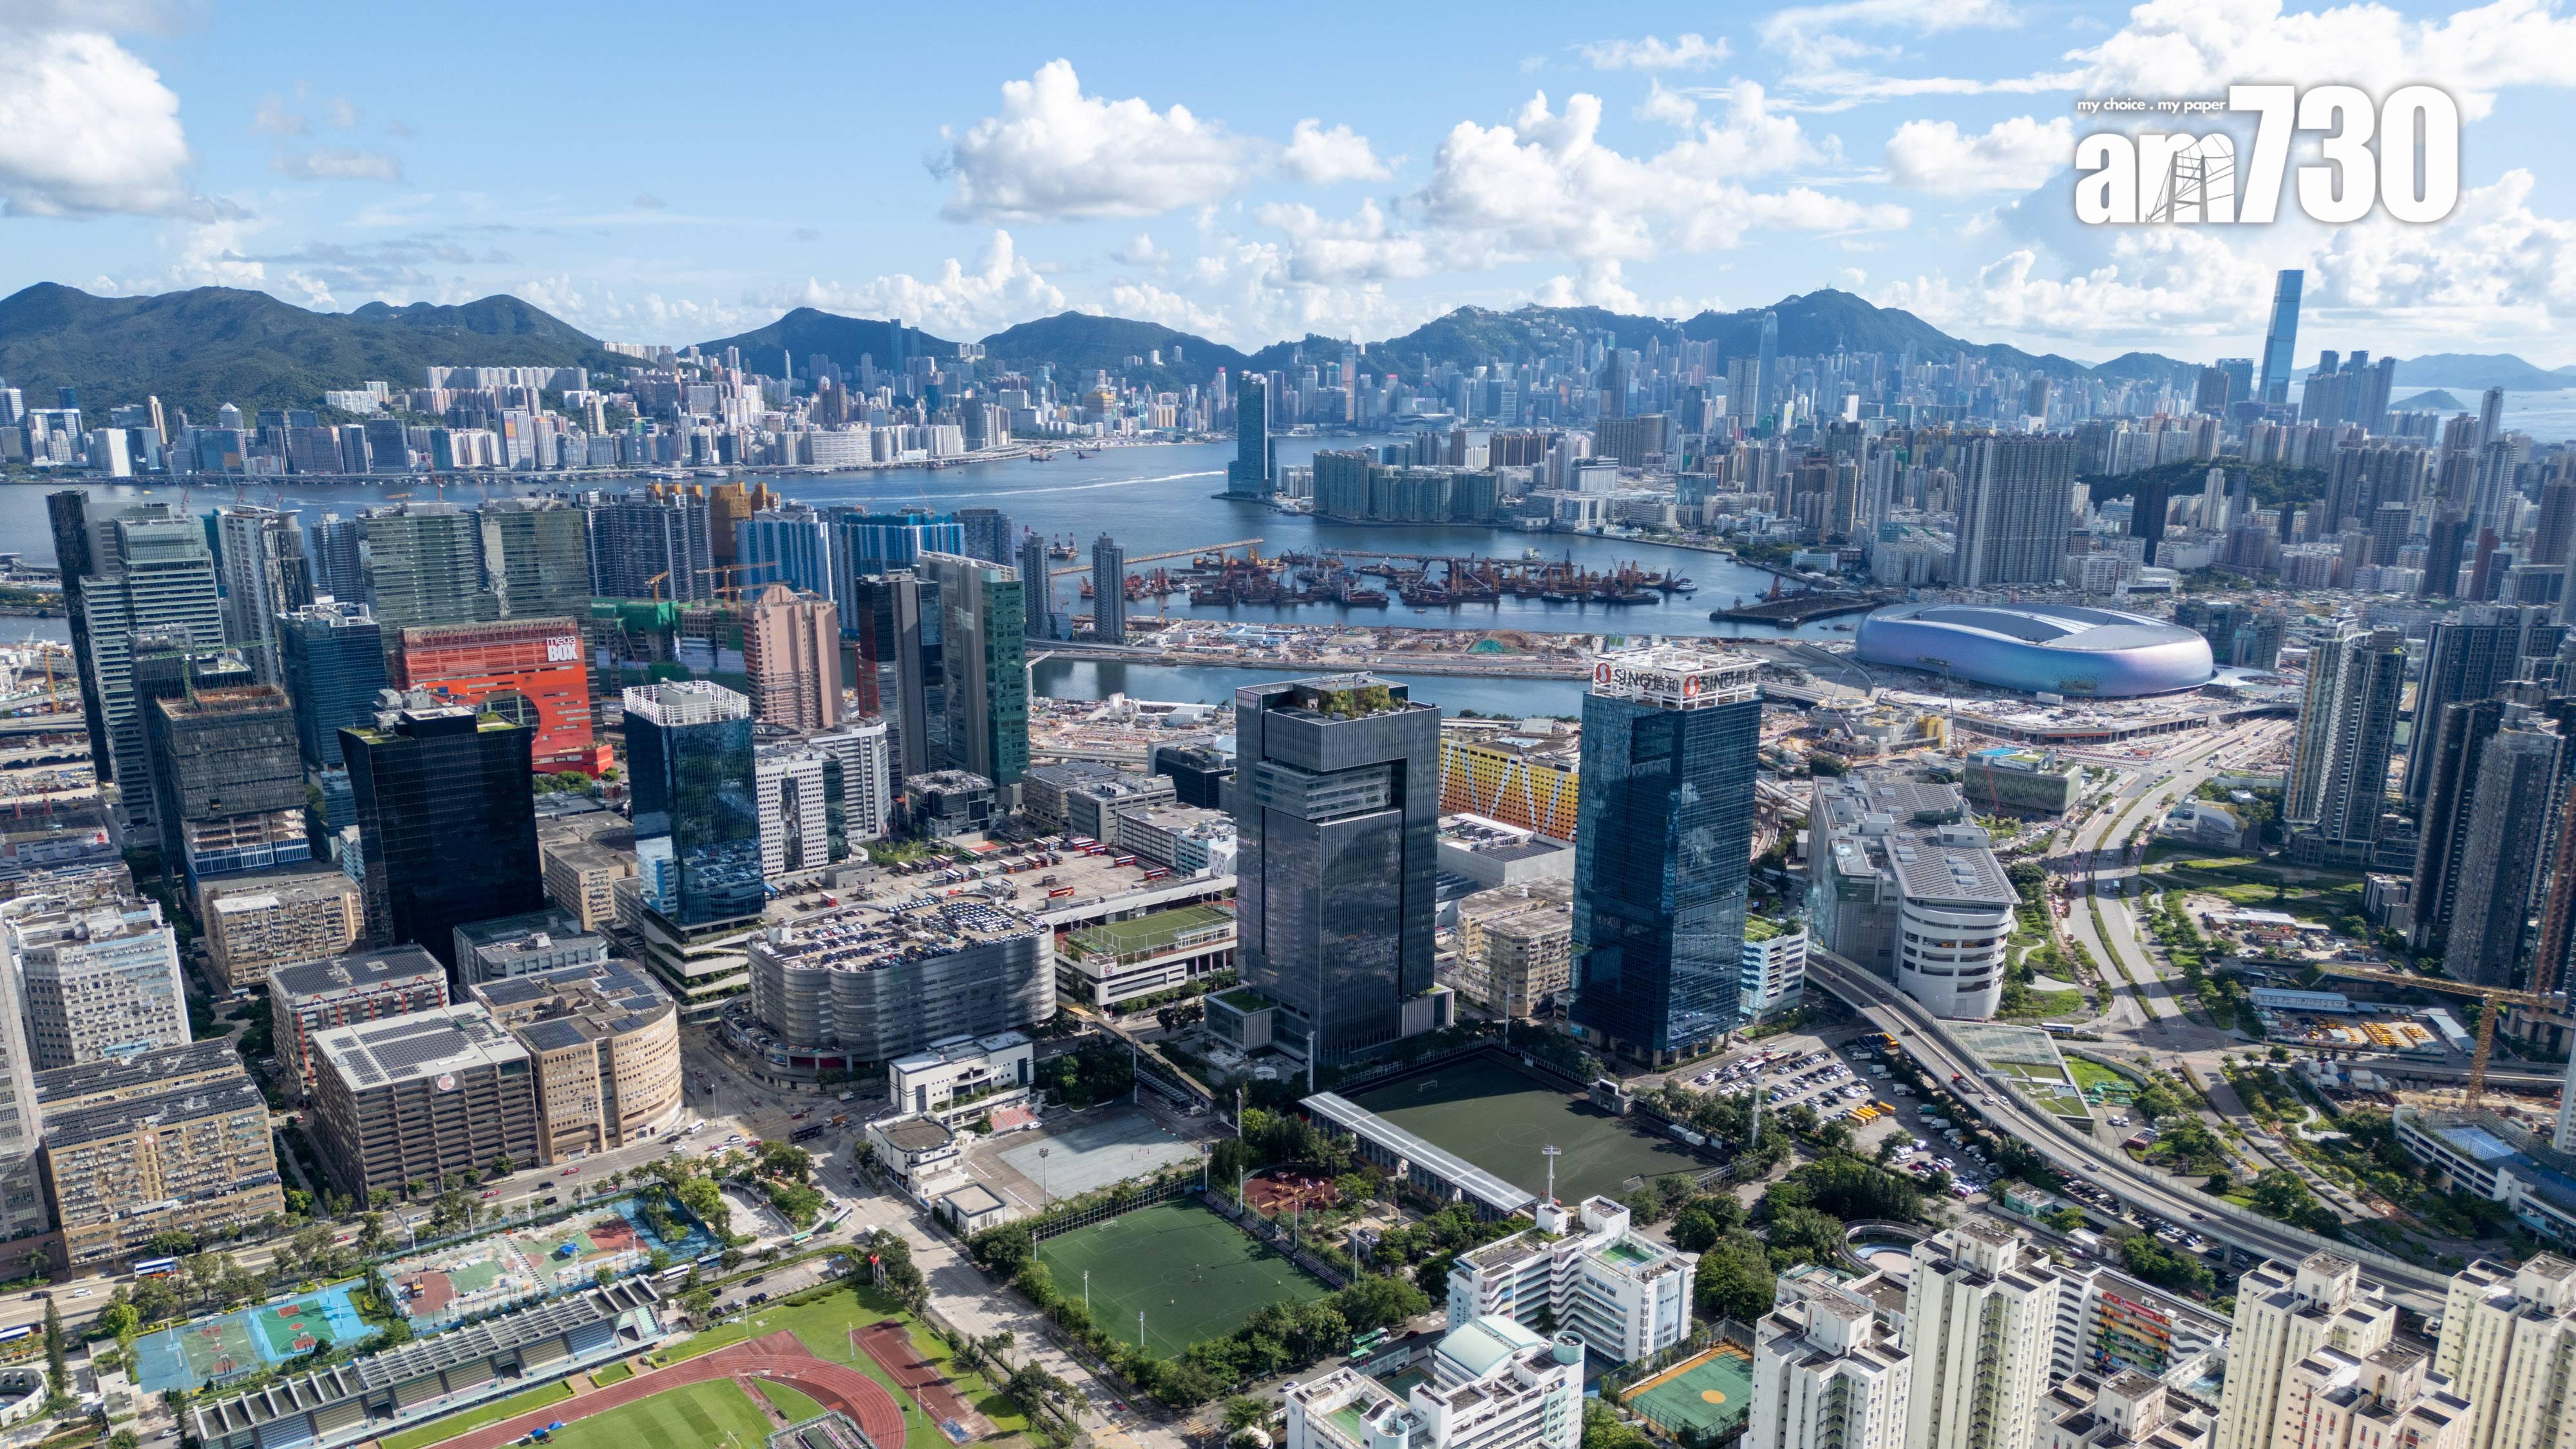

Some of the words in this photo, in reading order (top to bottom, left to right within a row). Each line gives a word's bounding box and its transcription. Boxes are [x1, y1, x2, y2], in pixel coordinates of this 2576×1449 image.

[547, 636, 576, 645] mega
[548, 644, 578, 661] BOX
[1614, 668, 1651, 687] SINO
[1651, 674, 1679, 692] 信和
